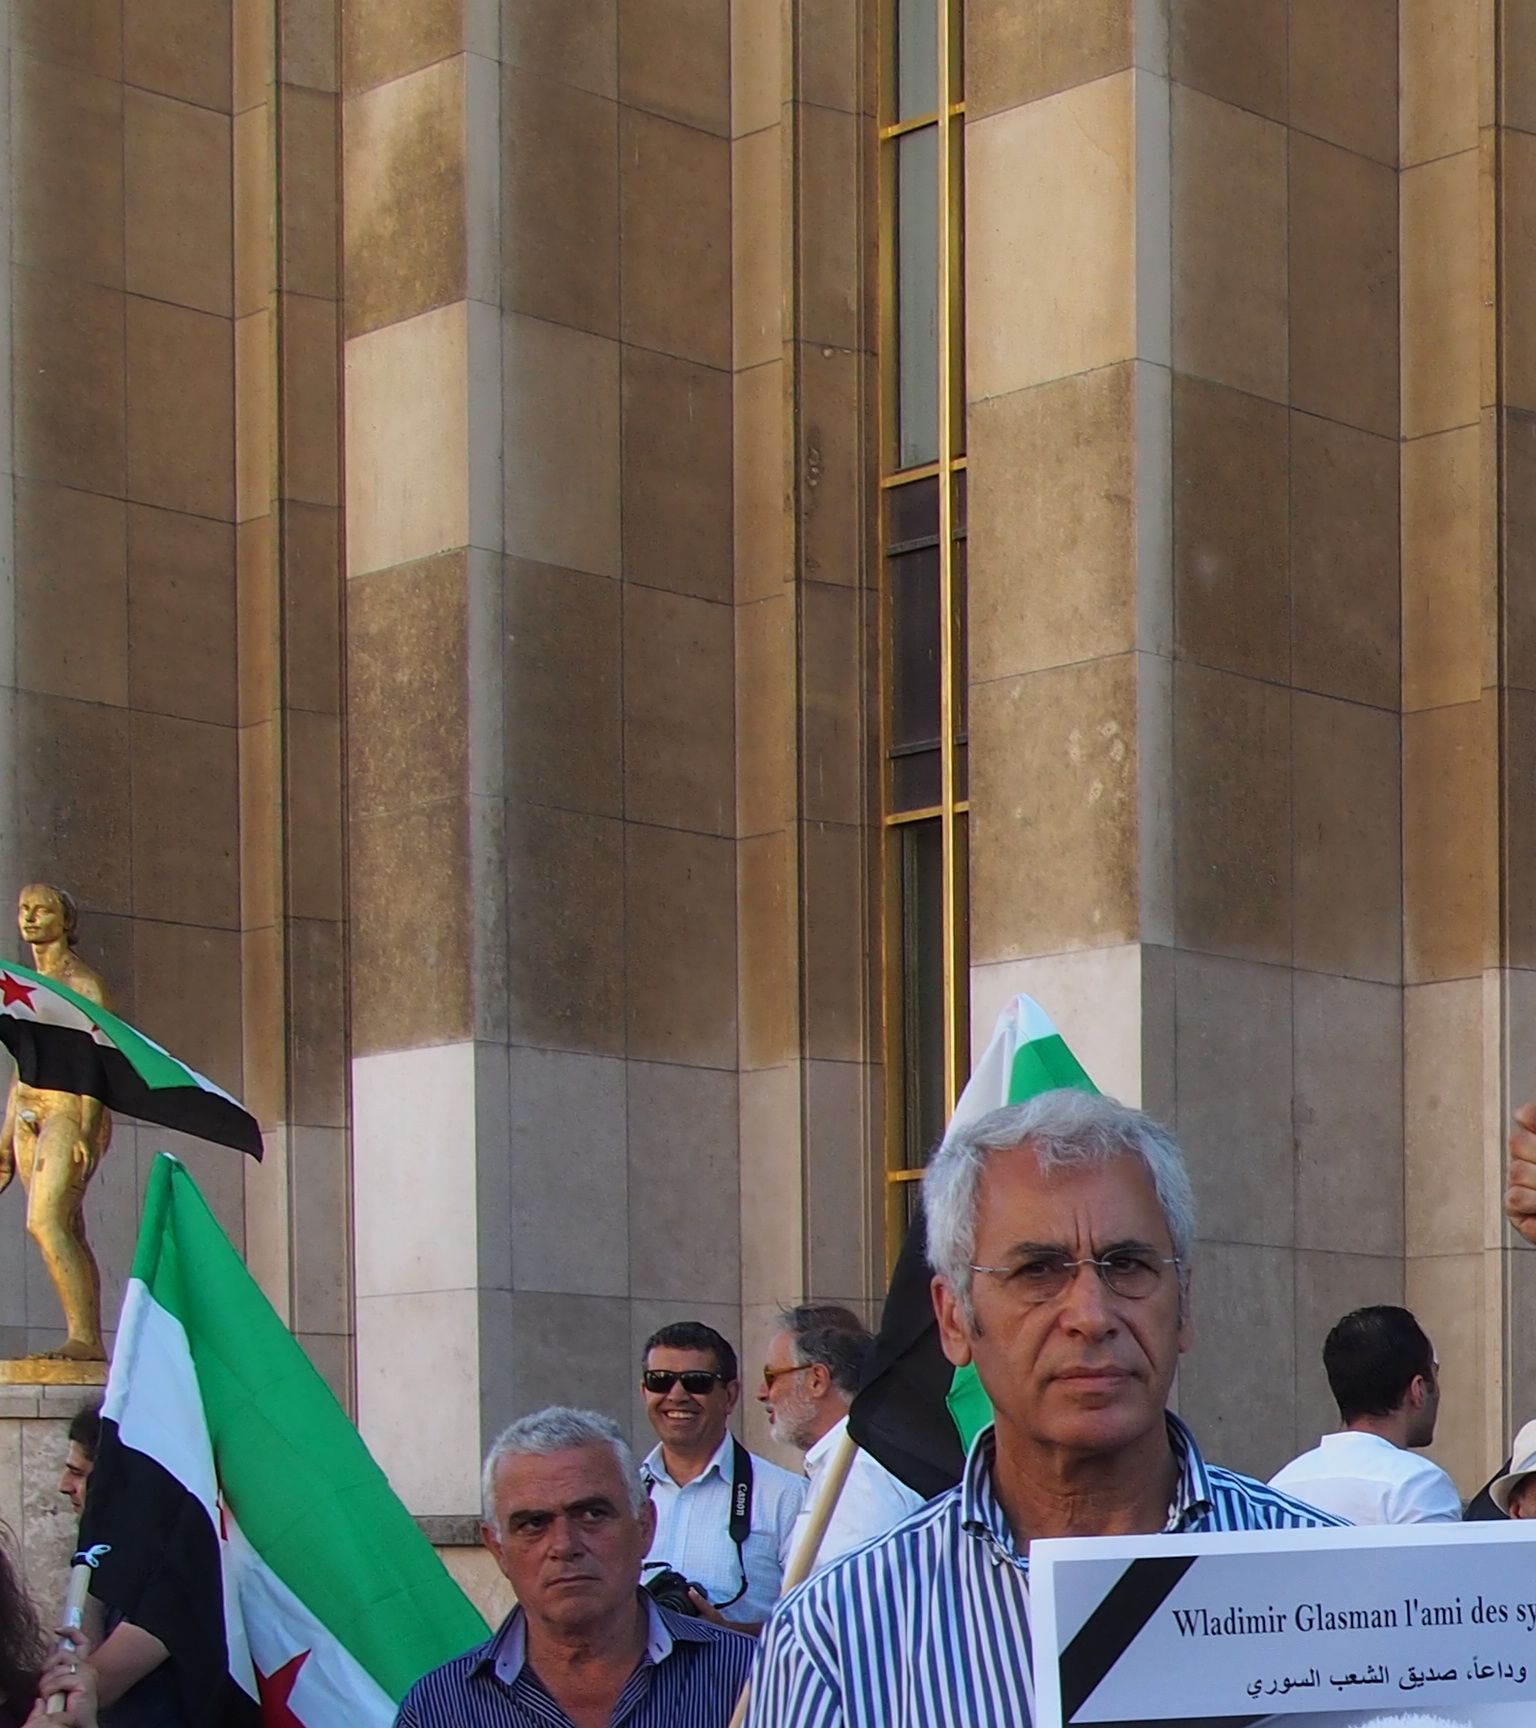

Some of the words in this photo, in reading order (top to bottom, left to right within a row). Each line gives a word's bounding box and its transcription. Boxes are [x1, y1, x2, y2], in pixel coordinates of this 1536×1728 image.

[736, 1483, 748, 1516] Canon
[1173, 1606, 1287, 1637] Wladimir
[1295, 1604, 1398, 1632] Glasman
[1404, 1599, 1462, 1627] l'ami
[1471, 1598, 1508, 1624] des
[1246, 1669, 1320, 1699] السوري
[1329, 1663, 1389, 1691] الشعب
[1399, 1666, 1458, 1691] صديق
